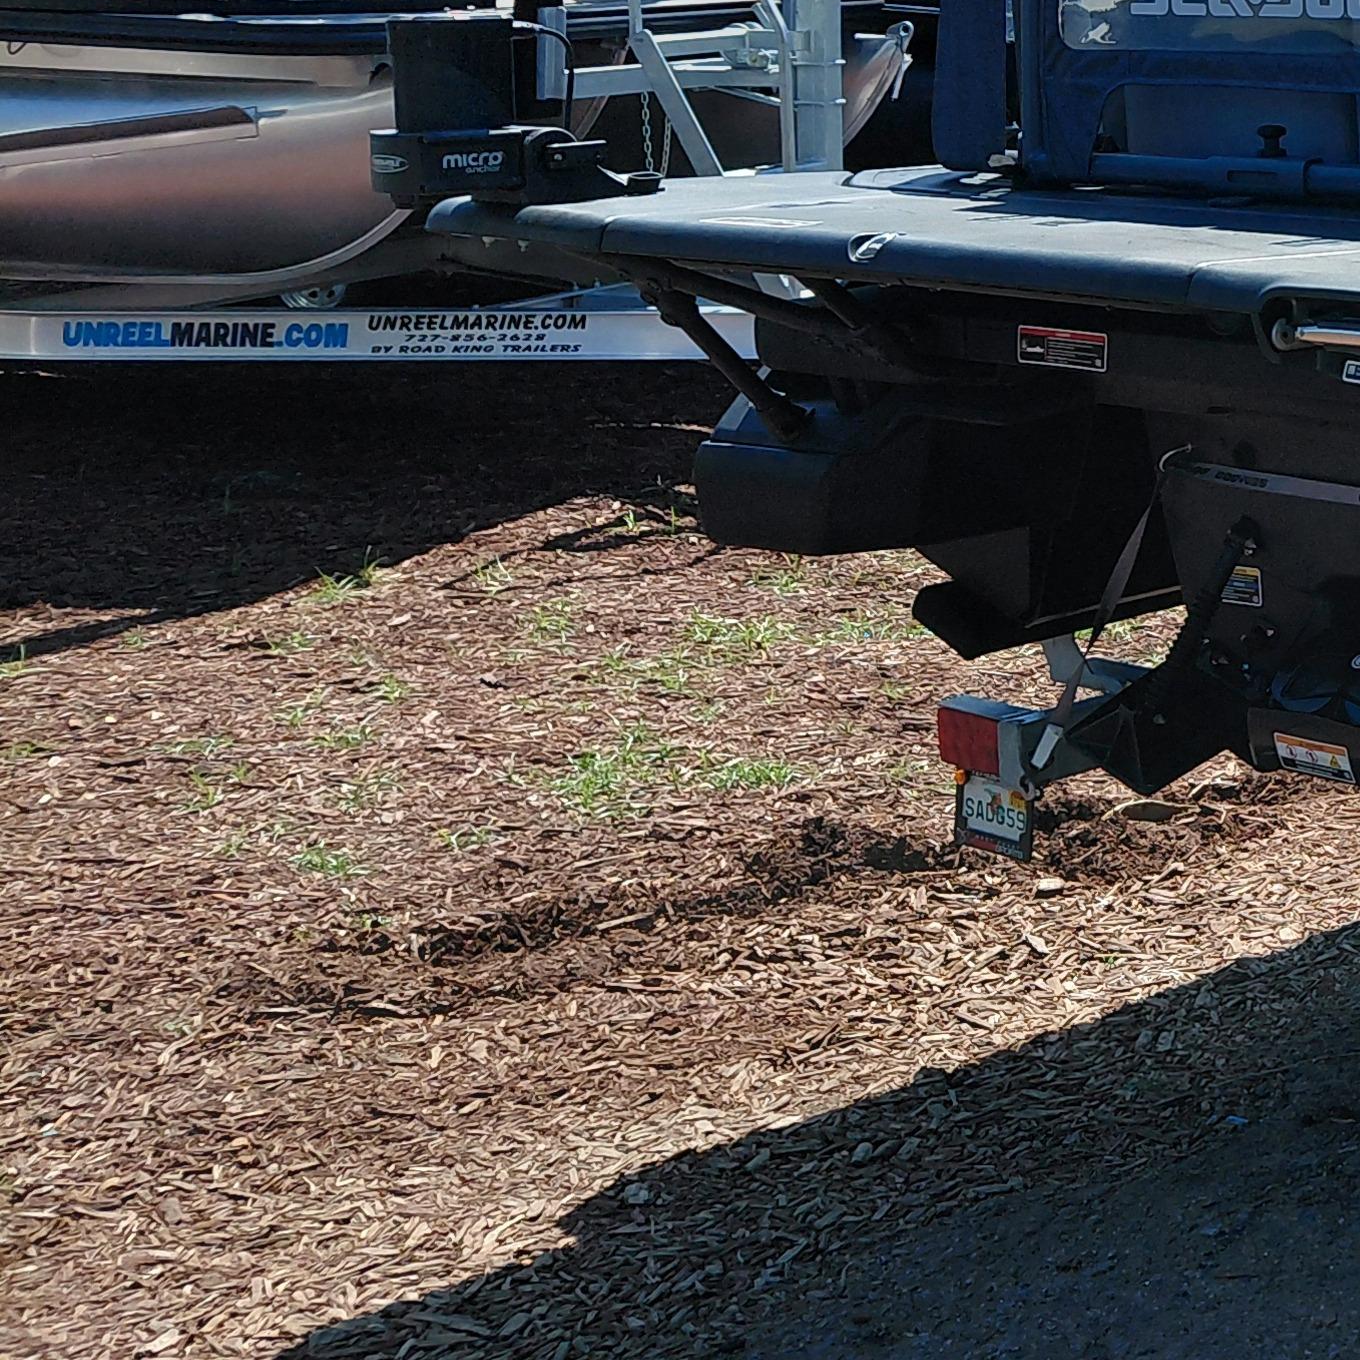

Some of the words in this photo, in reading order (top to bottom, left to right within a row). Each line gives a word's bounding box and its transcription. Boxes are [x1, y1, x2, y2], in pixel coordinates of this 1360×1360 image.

[442, 151, 503, 169] micro
[367, 314, 587, 332] UNREELMARINE.COM
[62, 321, 349, 348] UNREELMARINE.COM
[371, 345, 393, 354] BY
[398, 345, 446, 354] ROAD
[451, 344, 495, 353] KING
[502, 344, 582, 353] TRAILERS
